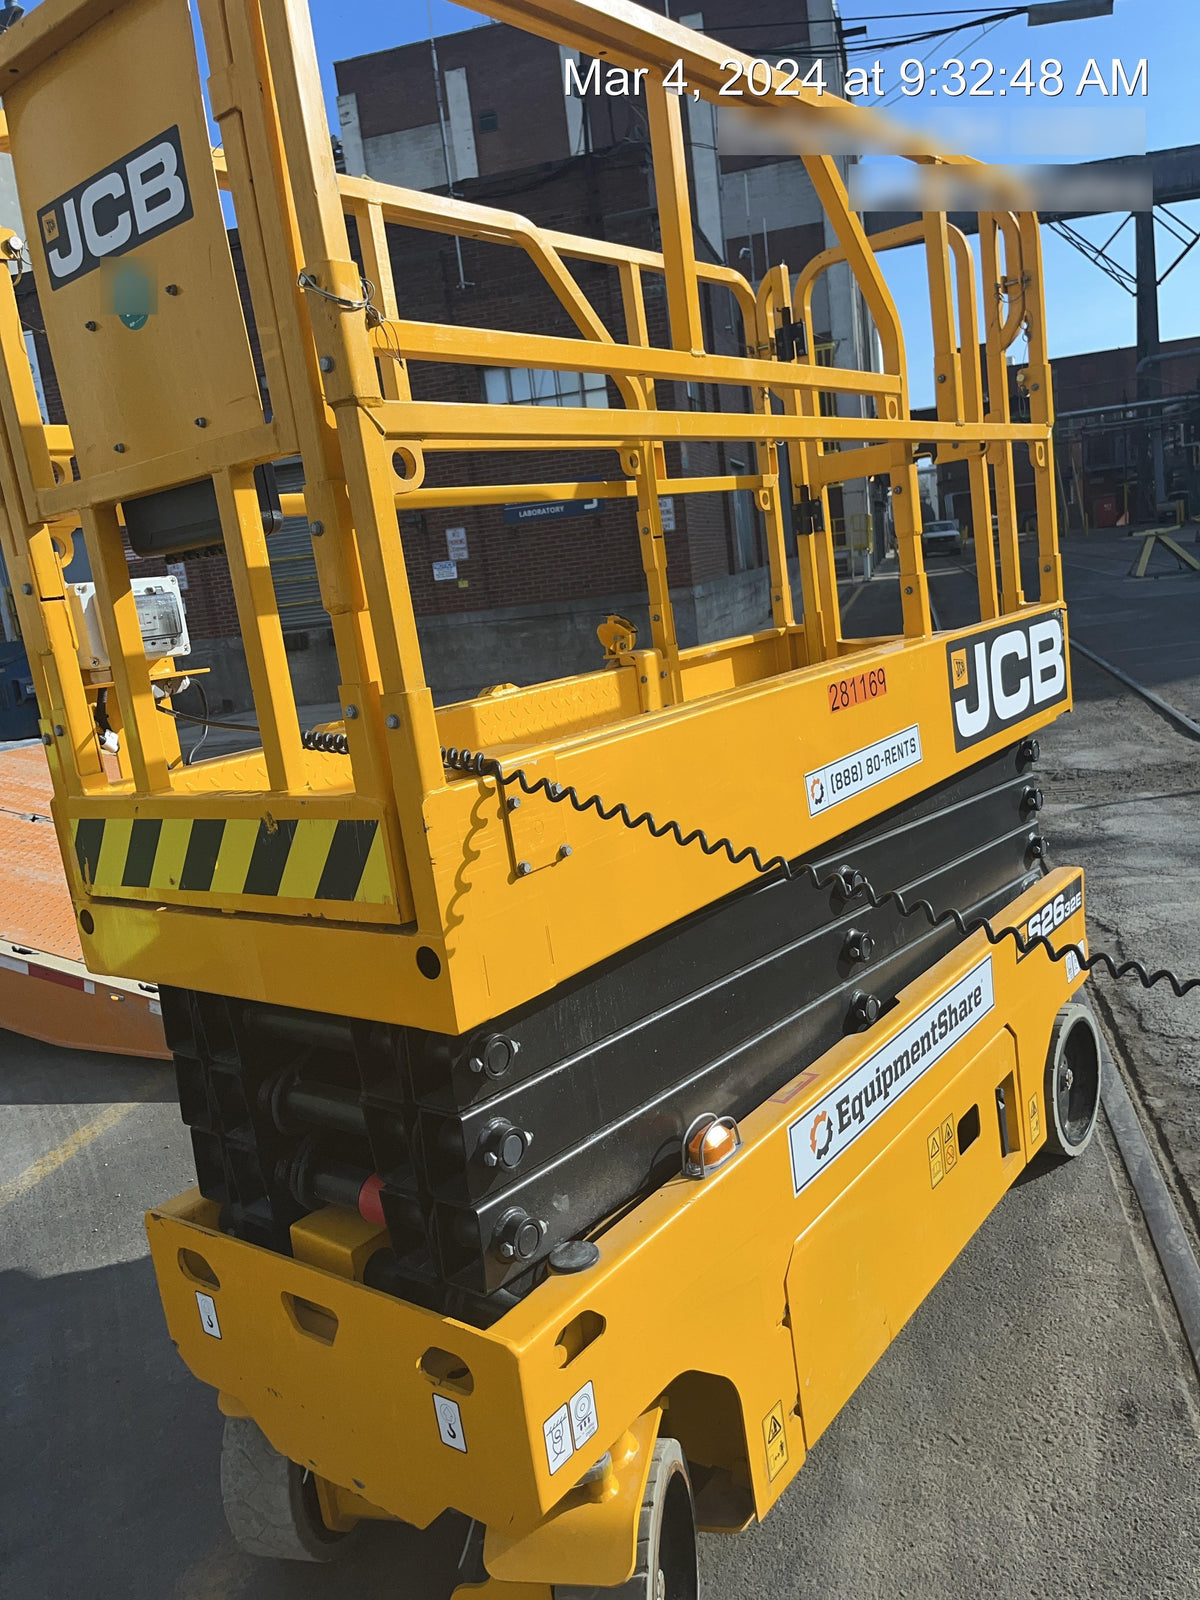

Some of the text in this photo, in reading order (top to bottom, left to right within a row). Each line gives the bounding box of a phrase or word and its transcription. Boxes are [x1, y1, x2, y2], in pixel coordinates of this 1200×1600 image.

[48, 141, 186, 278] JCB
[518, 506, 565, 518] LABORATORY
[829, 668, 887, 712] 281169
[954, 619, 1065, 738] JCB
[830, 737, 917, 795] (888) 80-RENTS
[835, 985, 982, 1135] EquipmentShare
